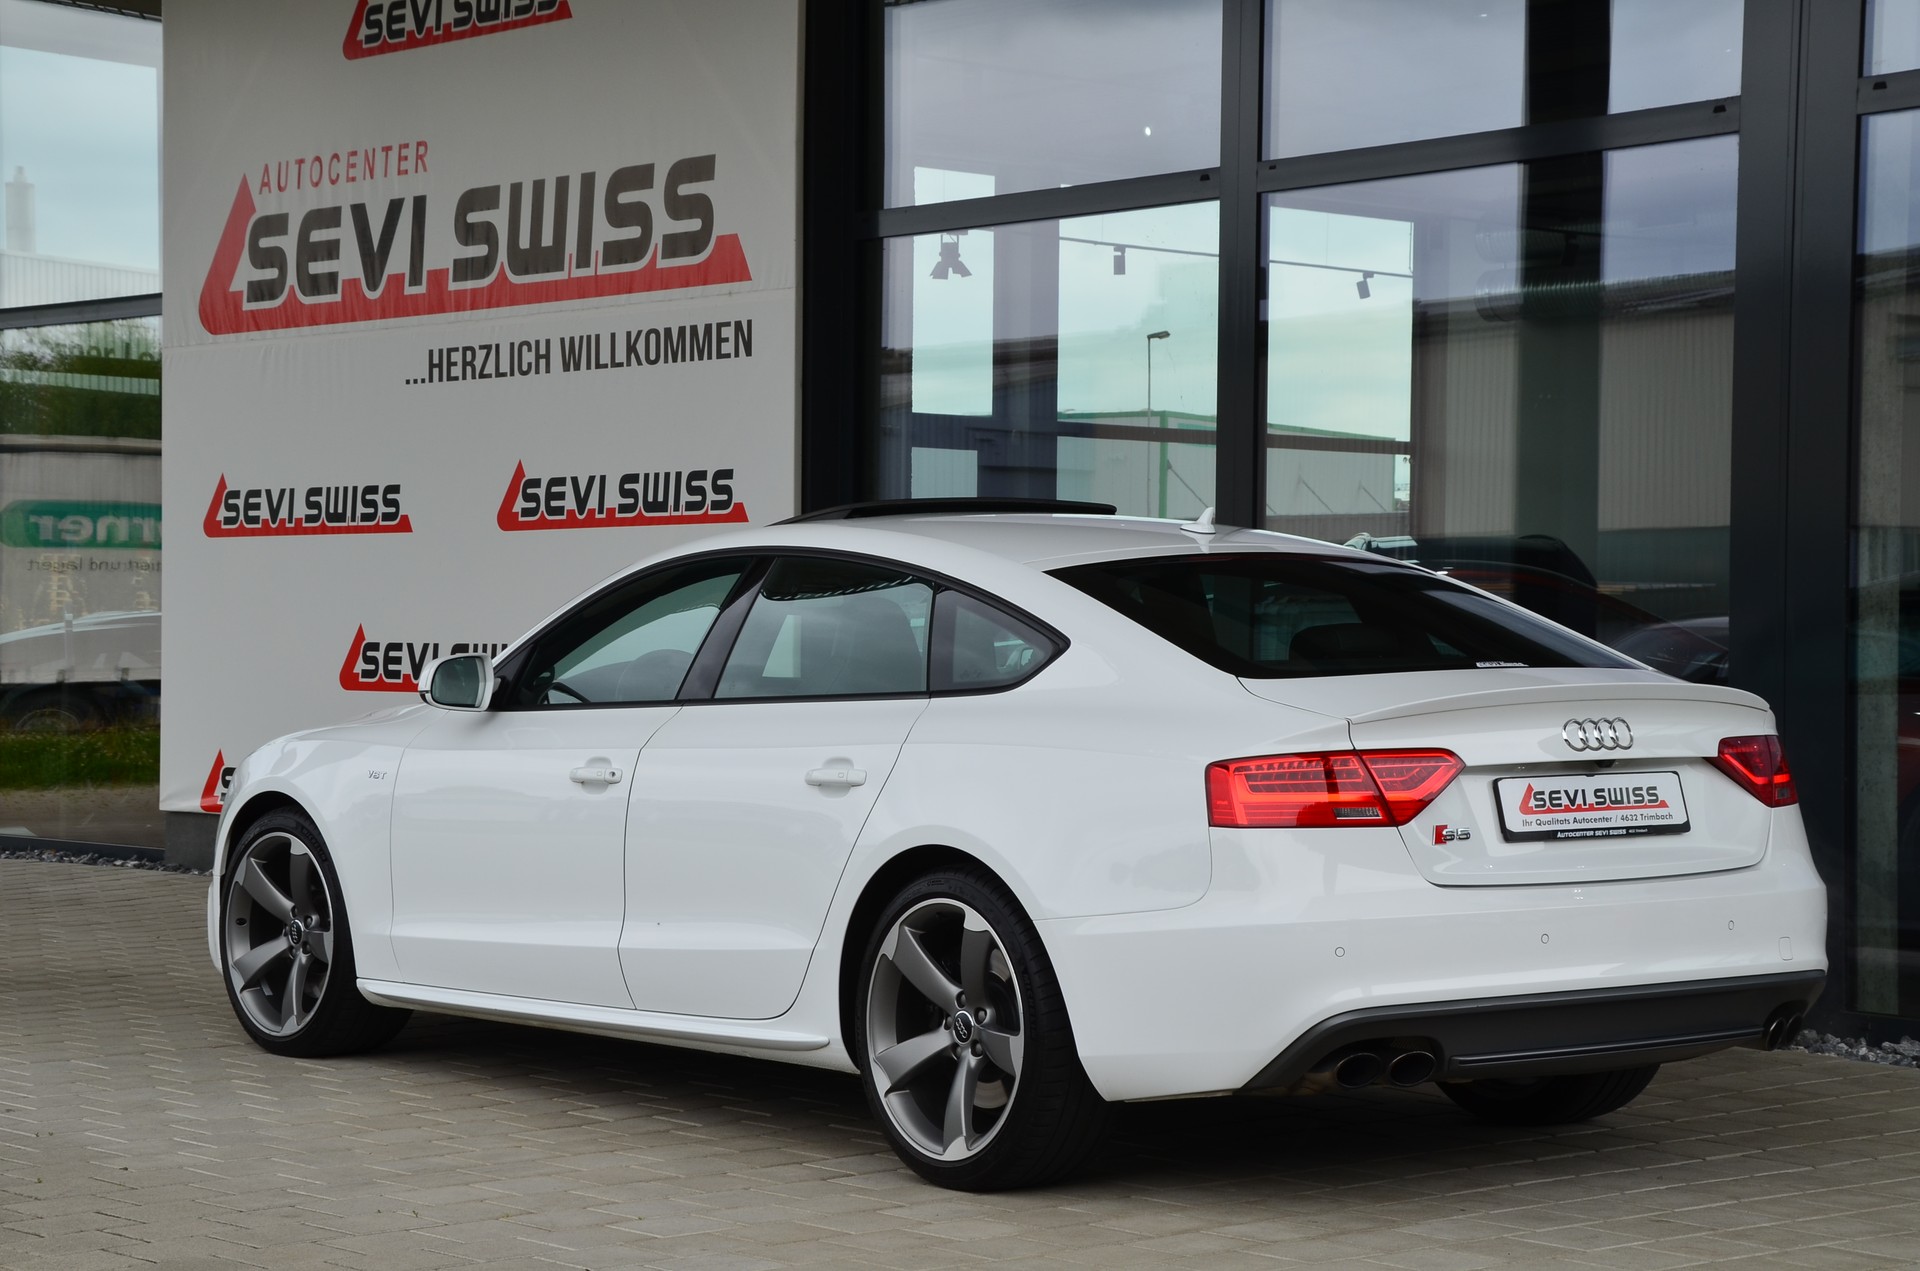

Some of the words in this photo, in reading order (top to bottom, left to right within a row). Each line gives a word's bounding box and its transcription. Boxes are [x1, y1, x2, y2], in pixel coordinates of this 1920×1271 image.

[364, 0, 443, 46] SEVI
[259, 140, 429, 195] AUTOCENTER
[245, 195, 427, 303] SEVI
[451, 154, 716, 283] SWISS
[405, 339, 551, 386] ...HERZLICH
[560, 319, 753, 374] WILLKOMMEN
[221, 487, 294, 526] SEVI
[303, 483, 401, 523] SWISS
[520, 474, 606, 519] SEVI
[618, 468, 734, 514] SWISS
[1522, 819, 1533, 827] Ihr
[1572, 815, 1613, 825] Autocenter
[1620, 813, 1638, 822] 4632
[1640, 812, 1673, 821] Trimbach
[1532, 788, 1587, 809] SEVI
[1593, 786, 1659, 806] SWISS
[1441, 828, 1471, 842] S5
[1556, 830, 1594, 839] AUTOCENTER
[1609, 828, 1626, 836] SWISS
